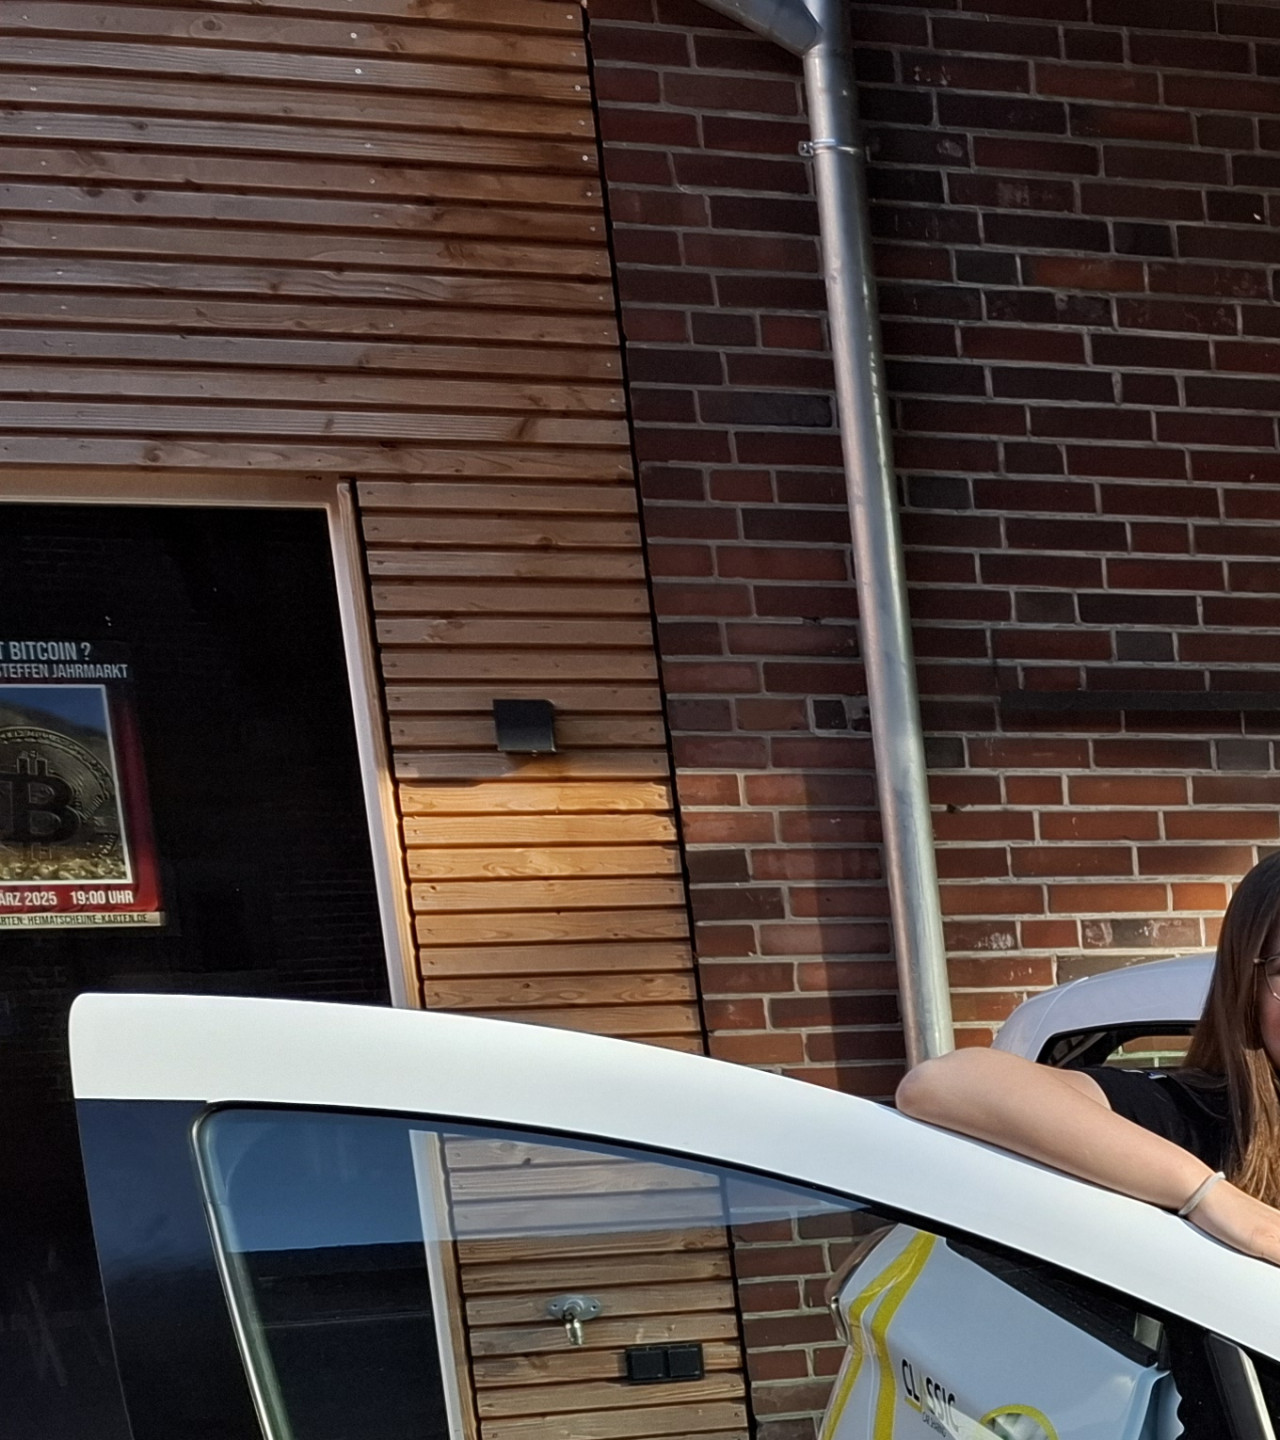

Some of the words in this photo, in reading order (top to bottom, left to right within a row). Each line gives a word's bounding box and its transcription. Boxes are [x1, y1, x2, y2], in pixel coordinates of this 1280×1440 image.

[9, 641, 77, 661] BITCOIN
[81, 642, 91, 660] ?
[52, 663, 128, 678] JAHRMARKT
[24, 891, 57, 905] 2025
[70, 890, 106, 904] 19:00
[108, 890, 134, 904] UHR
[0, 915, 25, 926] RTEN:
